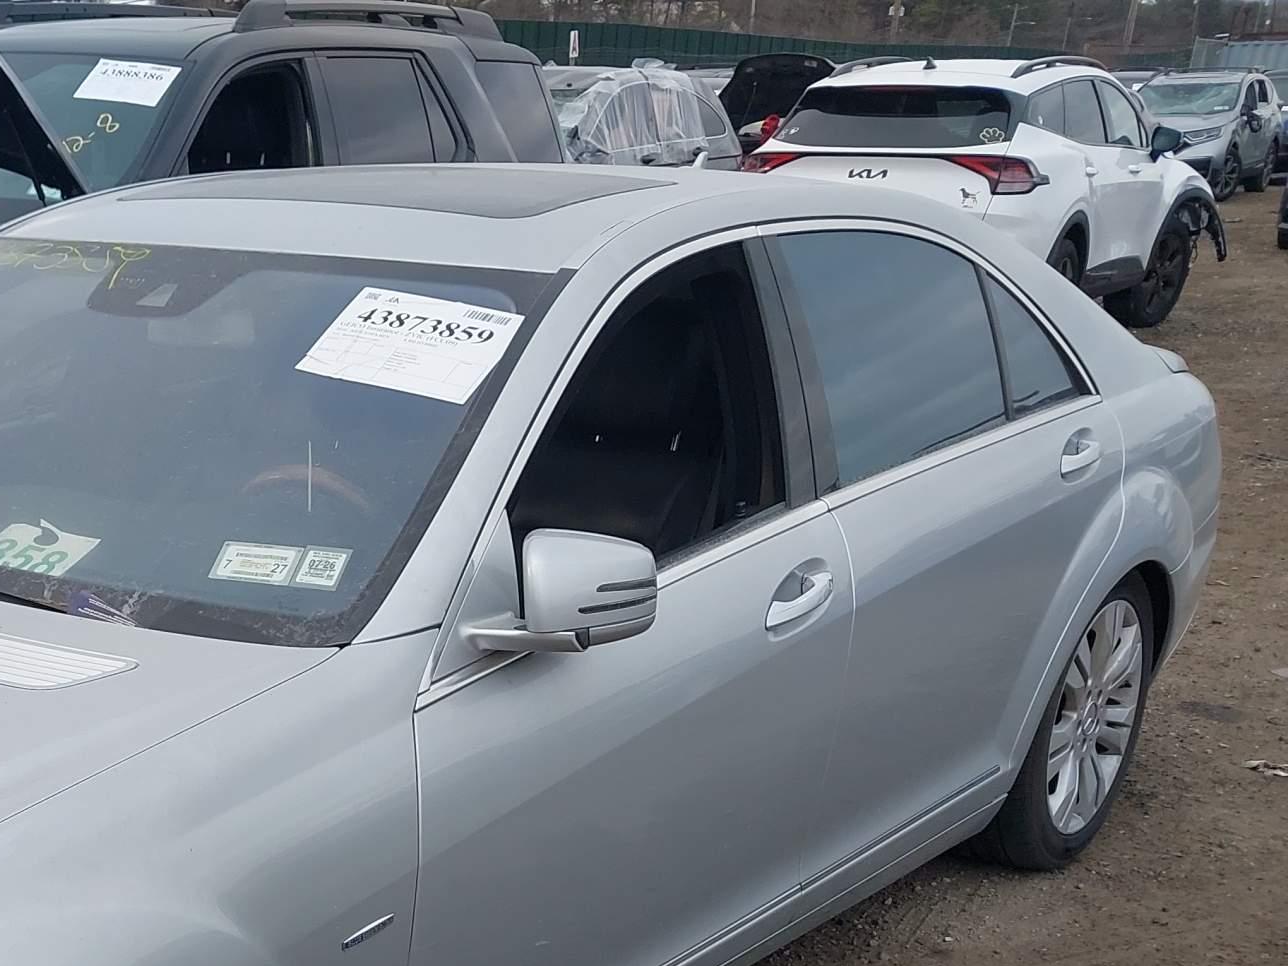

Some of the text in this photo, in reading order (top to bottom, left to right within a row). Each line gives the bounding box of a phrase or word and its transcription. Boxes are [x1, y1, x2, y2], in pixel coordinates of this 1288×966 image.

[357, 307, 495, 345] 43873859
[223, 559, 233, 569] 7
[270, 562, 289, 574] 27
